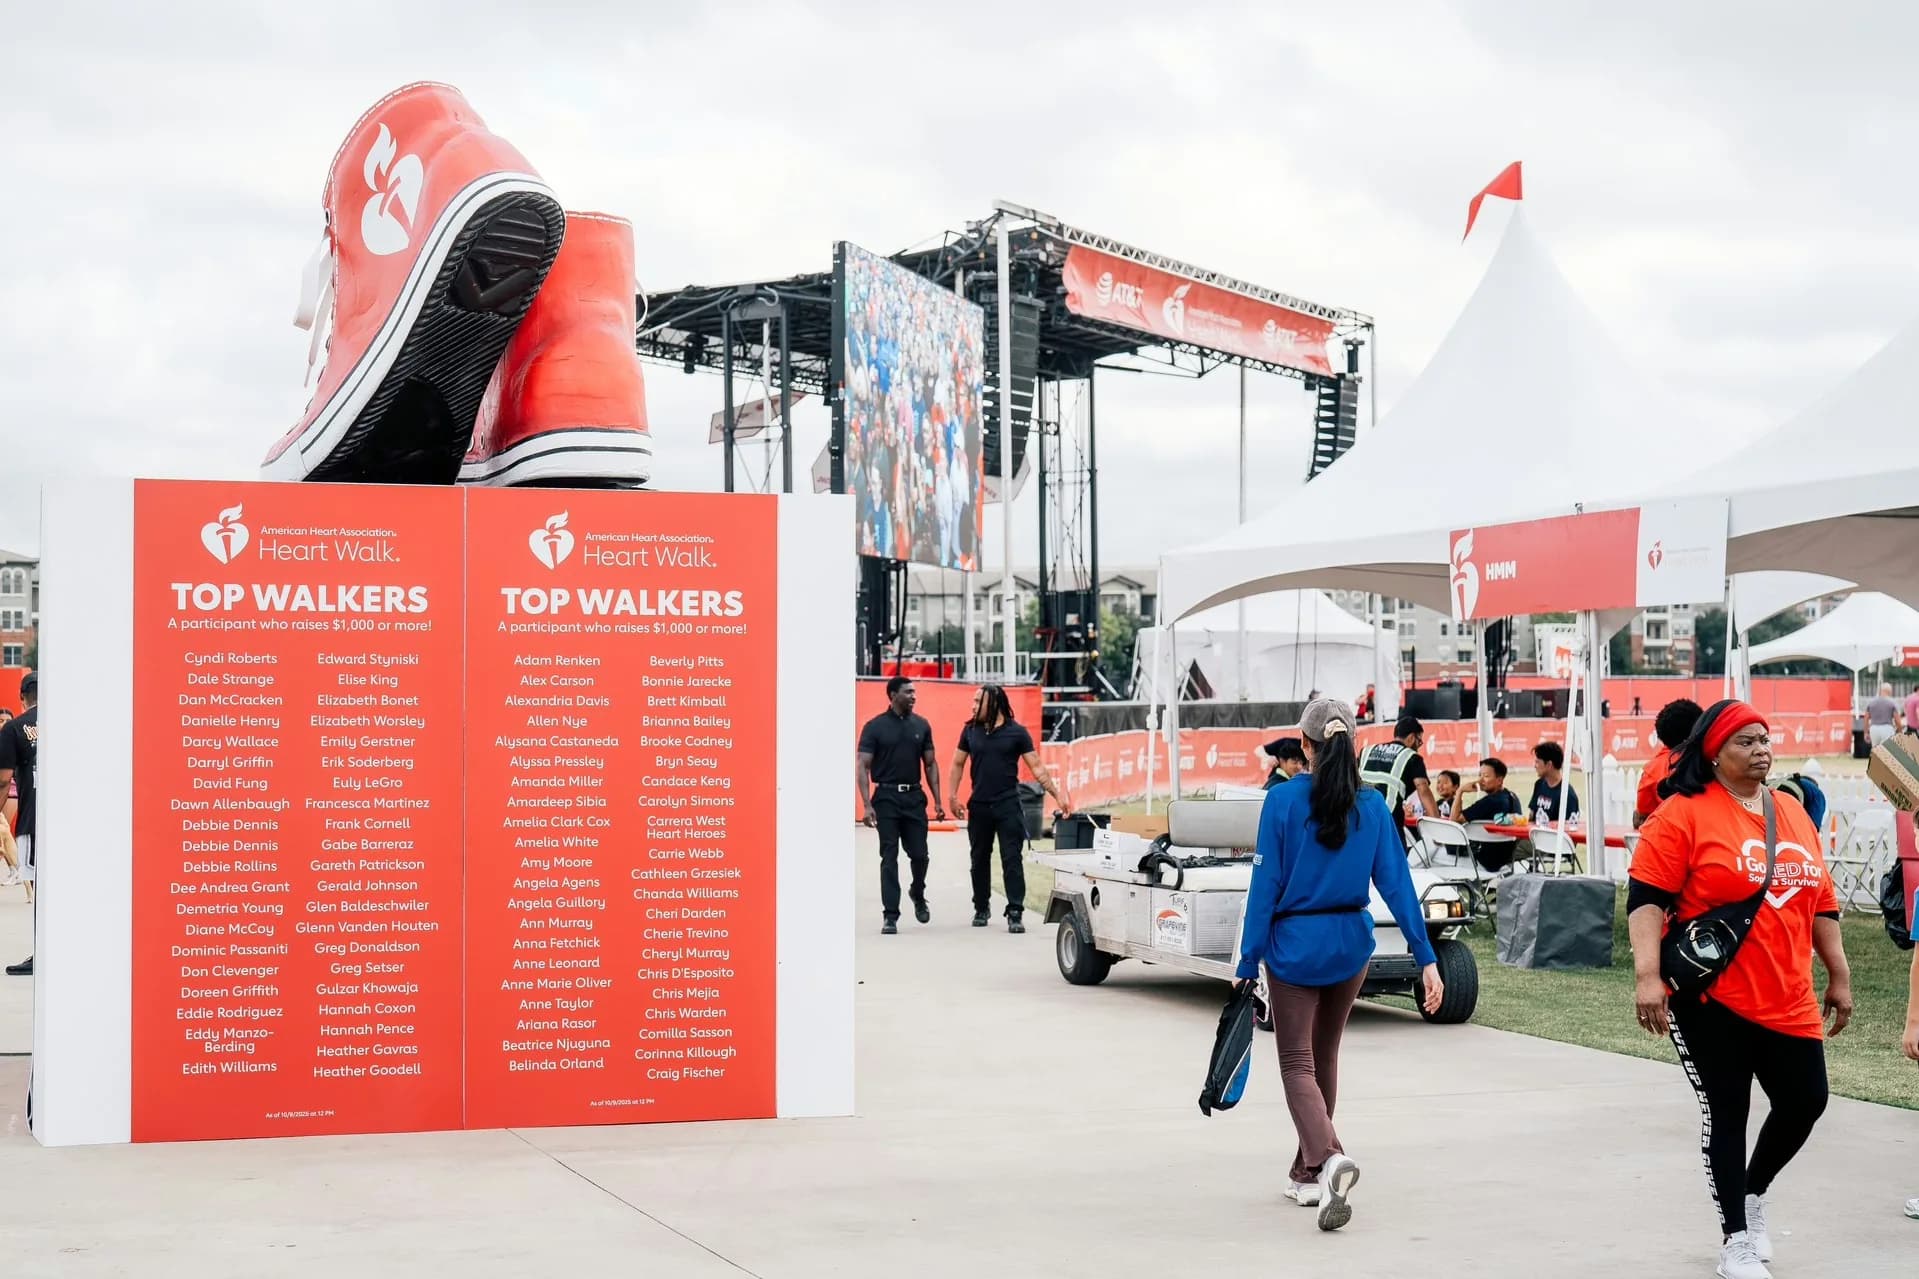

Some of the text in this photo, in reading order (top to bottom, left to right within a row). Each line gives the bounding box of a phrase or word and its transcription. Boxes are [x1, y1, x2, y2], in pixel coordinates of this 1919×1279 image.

[1112, 282, 1144, 309] AT&T
[260, 526, 308, 536] American
[309, 527, 338, 536] Heart
[585, 532, 630, 542] American
[631, 533, 658, 542] Heart
[259, 539, 328, 560] Heart
[584, 545, 649, 566] Heart
[1486, 560, 1516, 580] HMM
[170, 582, 428, 613] TOP WALKERS
[500, 587, 744, 617] TOP WALKERS
[167, 617, 432, 632] A participant who raises $1,000 or more!
[497, 621, 747, 635] A participant who raises $1,000 or more!
[184, 652, 278, 666] Cyndi Roberts
[514, 655, 600, 666] Adam Renken
[338, 674, 398, 688] Elise King
[642, 675, 732, 687] Bonnie Jarecke
[179, 694, 283, 706] Dan McCracken
[505, 695, 610, 706] Alexandria Davis
[310, 715, 425, 729] Elizabeth Worsley
[642, 715, 731, 729] Brianna Bailey
[182, 736, 279, 750] Darcy Wallace
[495, 735, 619, 749] Alysana Castaneda
[322, 756, 414, 770] Erik Soderberg
[656, 755, 718, 769] Bryn Seay
[193, 777, 268, 791] David Fung
[511, 776, 604, 787] Amanda Miller
[305, 798, 430, 809] Francesca Martinez
[638, 795, 735, 809] Carolyn Simons
[182, 819, 278, 831] Debbie Dennis
[503, 816, 611, 828] Amelia Clark Cox
[646, 828, 726, 839] Heart Heroes
[321, 838, 414, 850] Gabe Barreraz
[183, 860, 278, 873] Debbie Rollins
[520, 857, 593, 870] Amy Moore
[1736, 856, 1742, 872] I
[1802, 861, 1822, 878] for
[631, 867, 742, 880] Cathleen Grzesiek
[317, 880, 418, 892] Gerald Johnson
[1781, 878, 1820, 888] Survivor
[176, 902, 284, 916] Demetria Young
[507, 896, 606, 911] Angela Guillory
[646, 907, 726, 920] Cheri Darden
[295, 920, 439, 934] Glenn Vanden Houten
[512, 936, 600, 949] Anna Fetchick
[171, 944, 288, 957] Dominic Passaniti
[642, 948, 730, 962] Cheryl Murray
[330, 962, 405, 976] Greg Setser
[638, 968, 734, 980] Chris D'Esposito
[500, 977, 612, 990] Anne Marie Oliver
[181, 984, 279, 998] Doreen Griffith
[652, 987, 720, 1000] Chris Mejia
[319, 1003, 416, 1016] Hannah Coxon
[516, 1018, 597, 1030] Ariana Rasor
[185, 1028, 274, 1042] Eddy Manzo-
[317, 1044, 418, 1057] Heather Gavras
[182, 1061, 278, 1075] Edith Williams
[313, 1062, 422, 1078] Heather Goodell
[509, 1057, 605, 1072] Belinda Orland
[646, 1066, 725, 1082] Craig Fischer
[1696, 1090, 1712, 1148] NEVER
